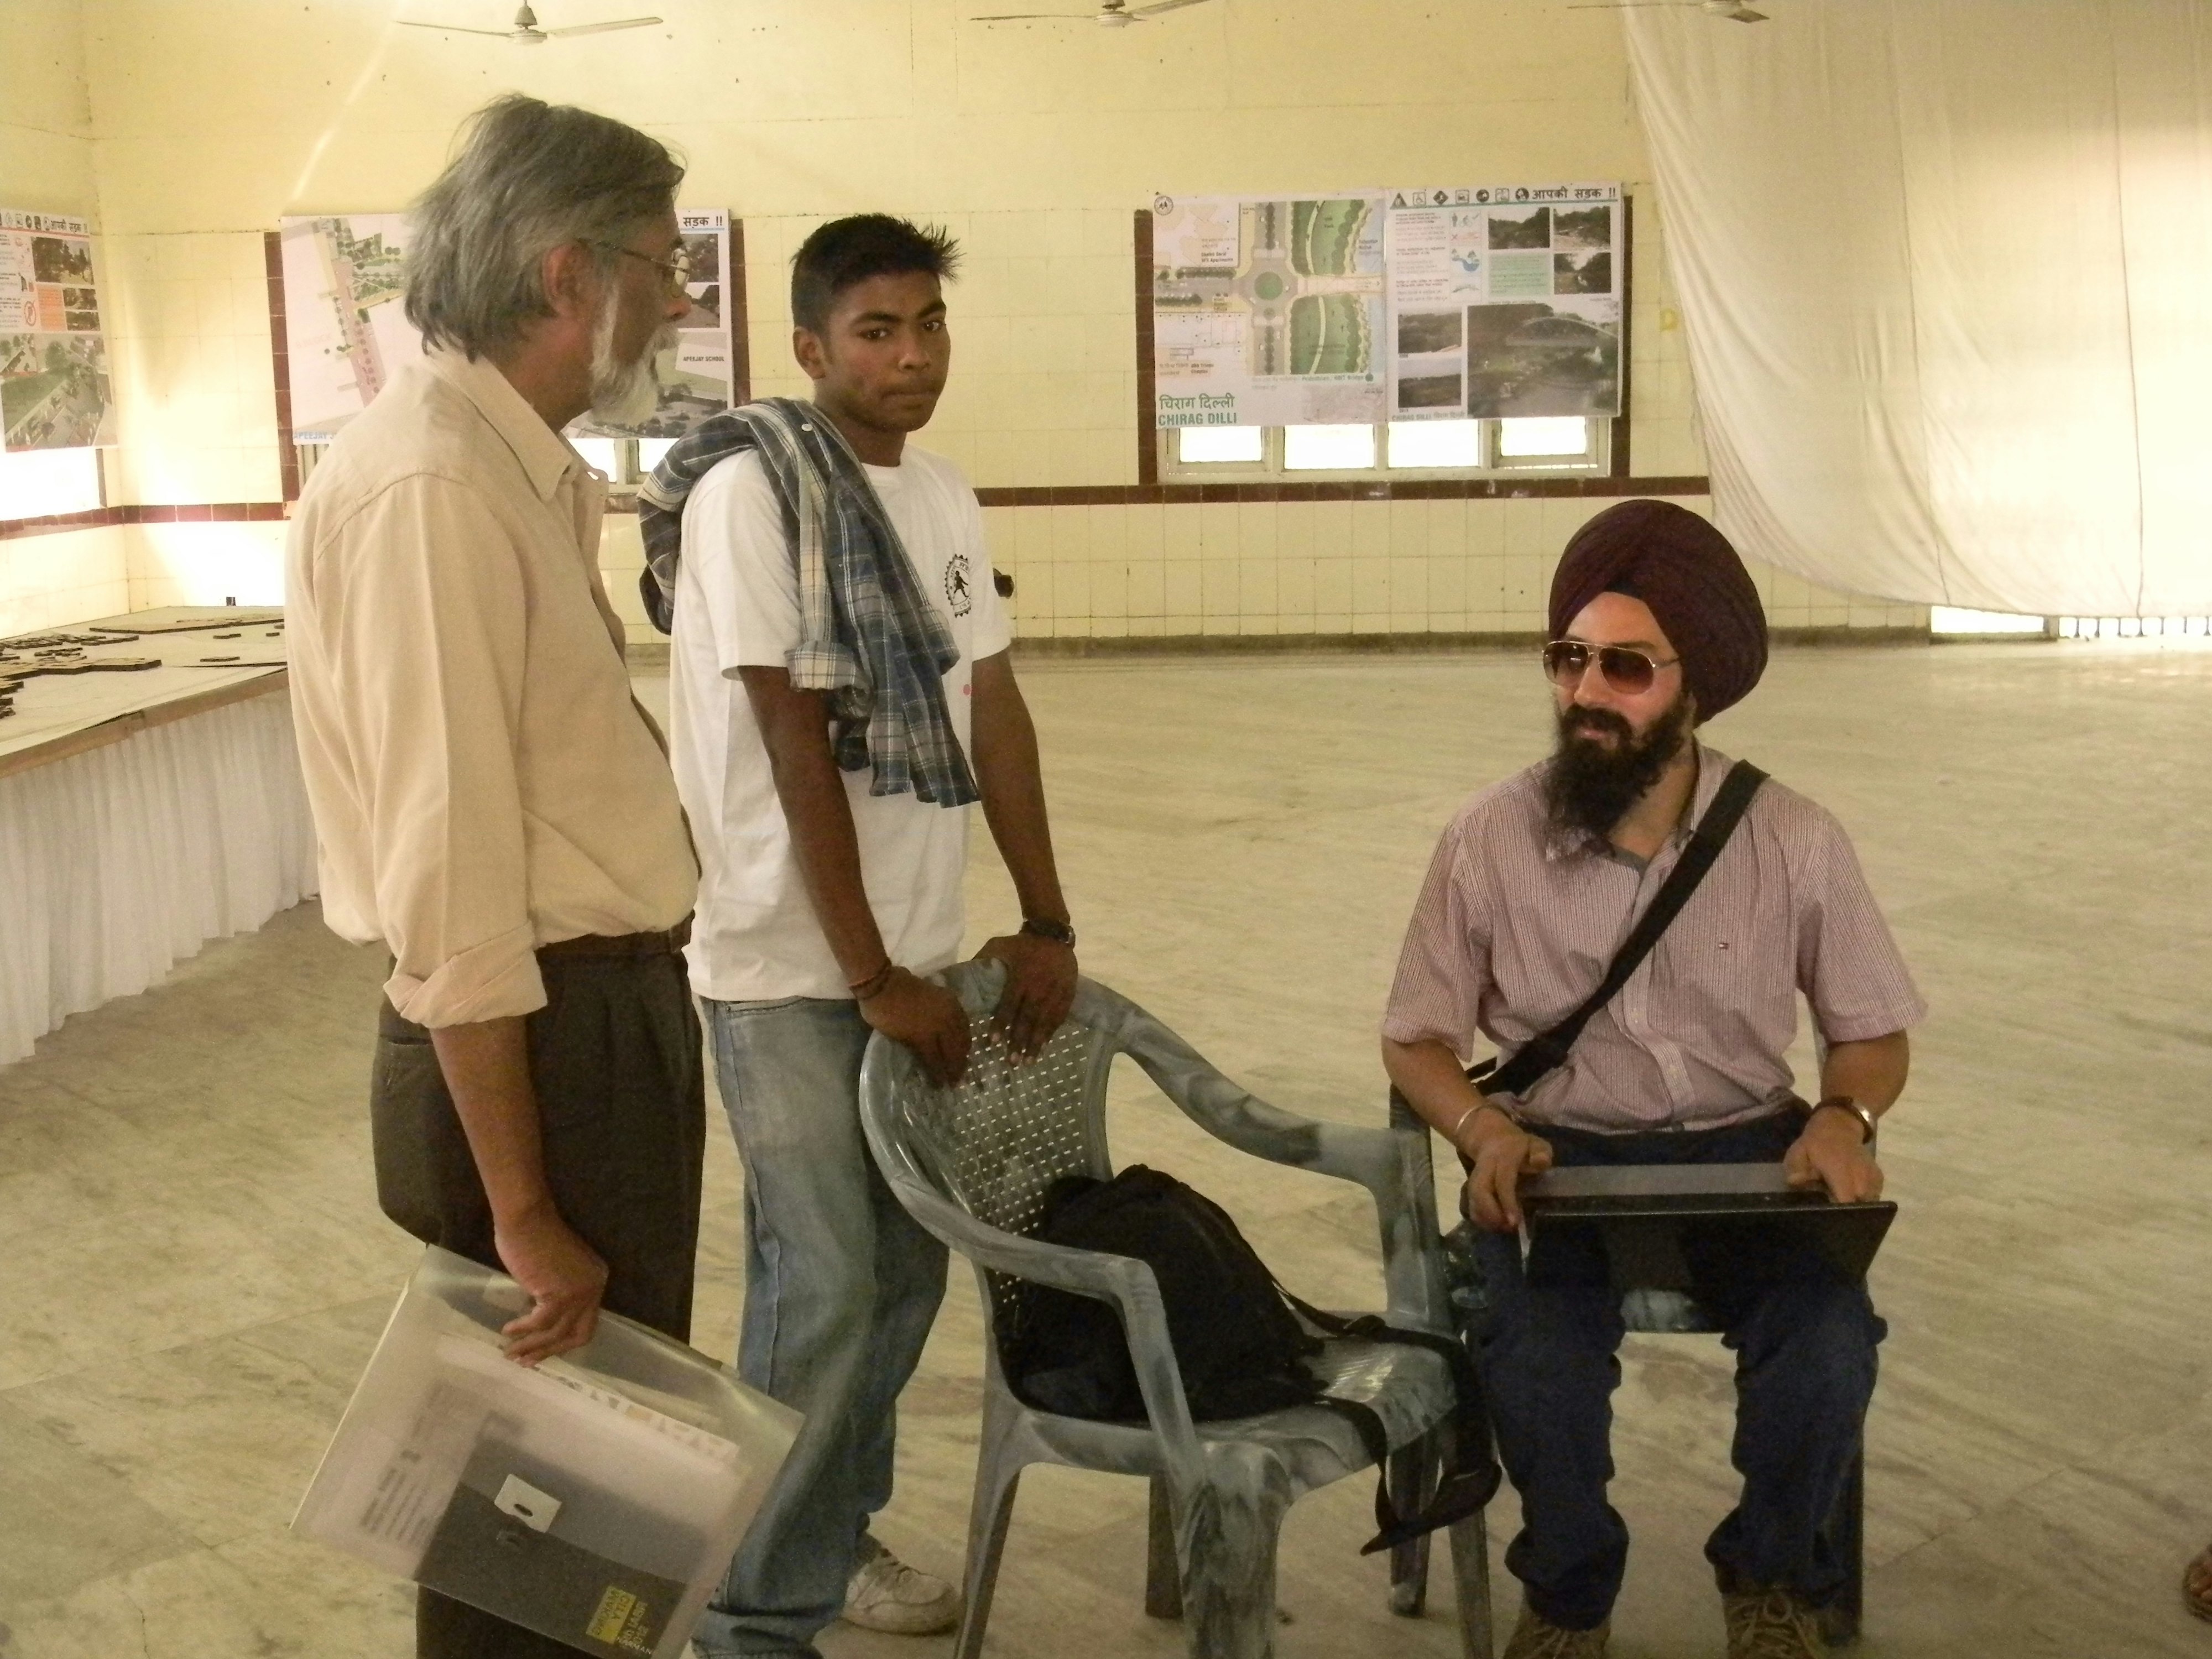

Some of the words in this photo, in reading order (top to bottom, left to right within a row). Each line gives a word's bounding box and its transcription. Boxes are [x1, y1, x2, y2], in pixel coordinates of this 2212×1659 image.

[1532, 186, 1568, 200] आपकी
[682, 217, 710, 229] सड़क
[716, 216, 723, 226] !!
[1159, 394, 1196, 410] चिराग
[1198, 392, 1235, 410] दिल्ली
[1158, 413, 1203, 426] CHIRAG
[1207, 412, 1237, 424] DILLI
[294, 431, 328, 440] APEEJAY
